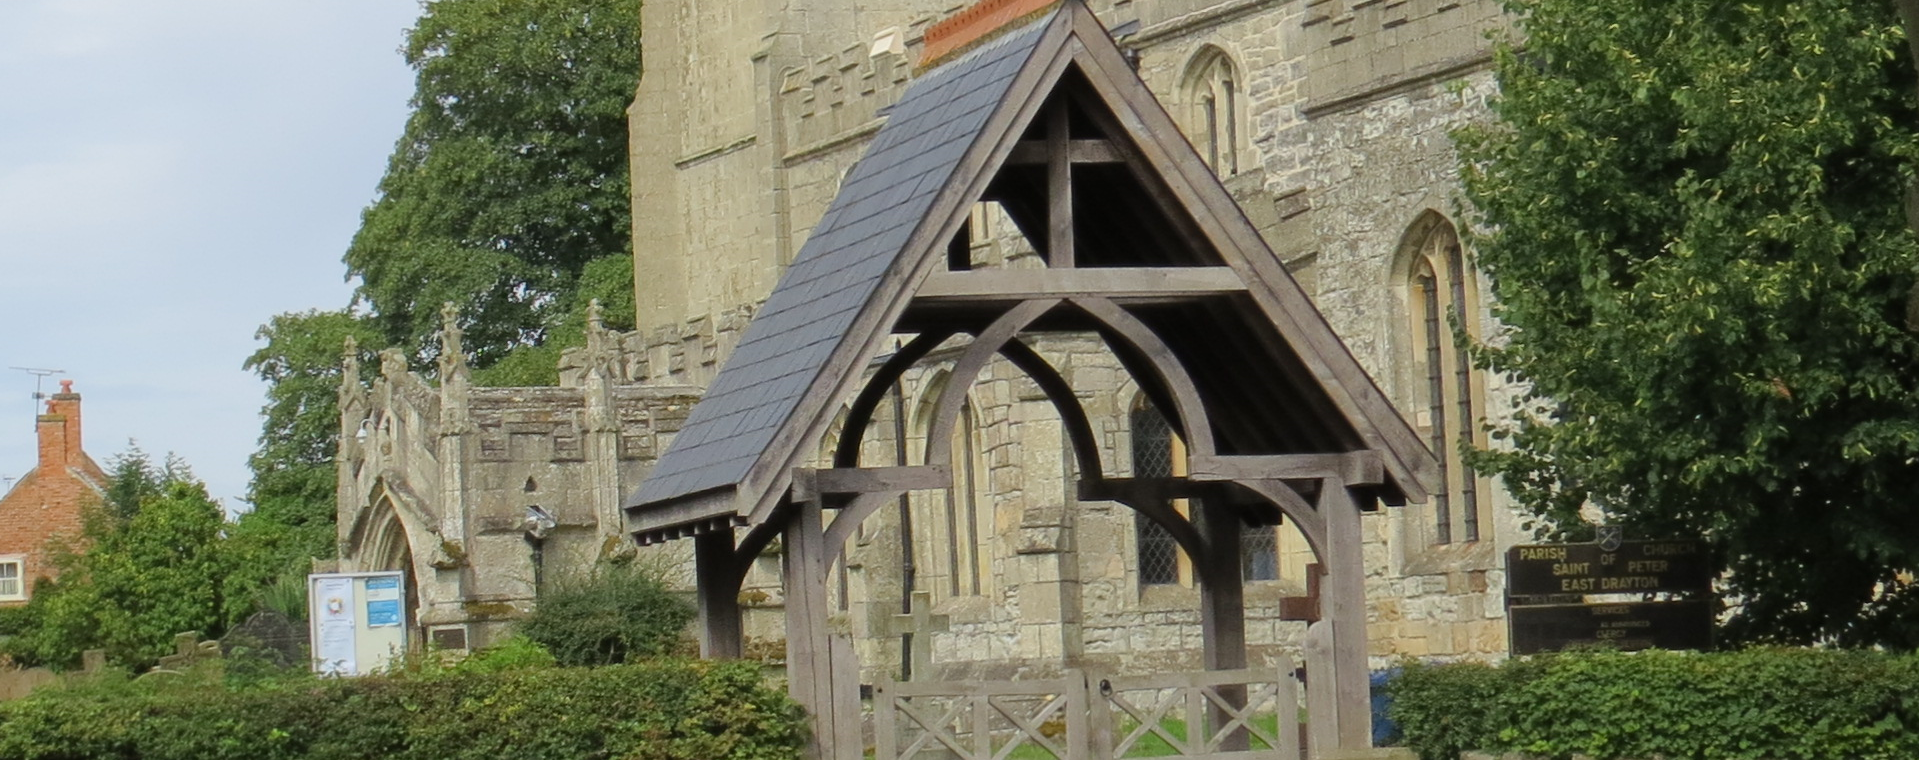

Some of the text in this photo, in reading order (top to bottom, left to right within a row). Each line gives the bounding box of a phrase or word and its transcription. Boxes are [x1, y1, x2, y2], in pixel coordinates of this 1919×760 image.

[1520, 543, 1696, 560] PARISH CHURCH
[1601, 554, 1616, 565] OF
[1553, 560, 1668, 576] SAINT PETER
[1562, 577, 1659, 591] EAST DRAYTON
